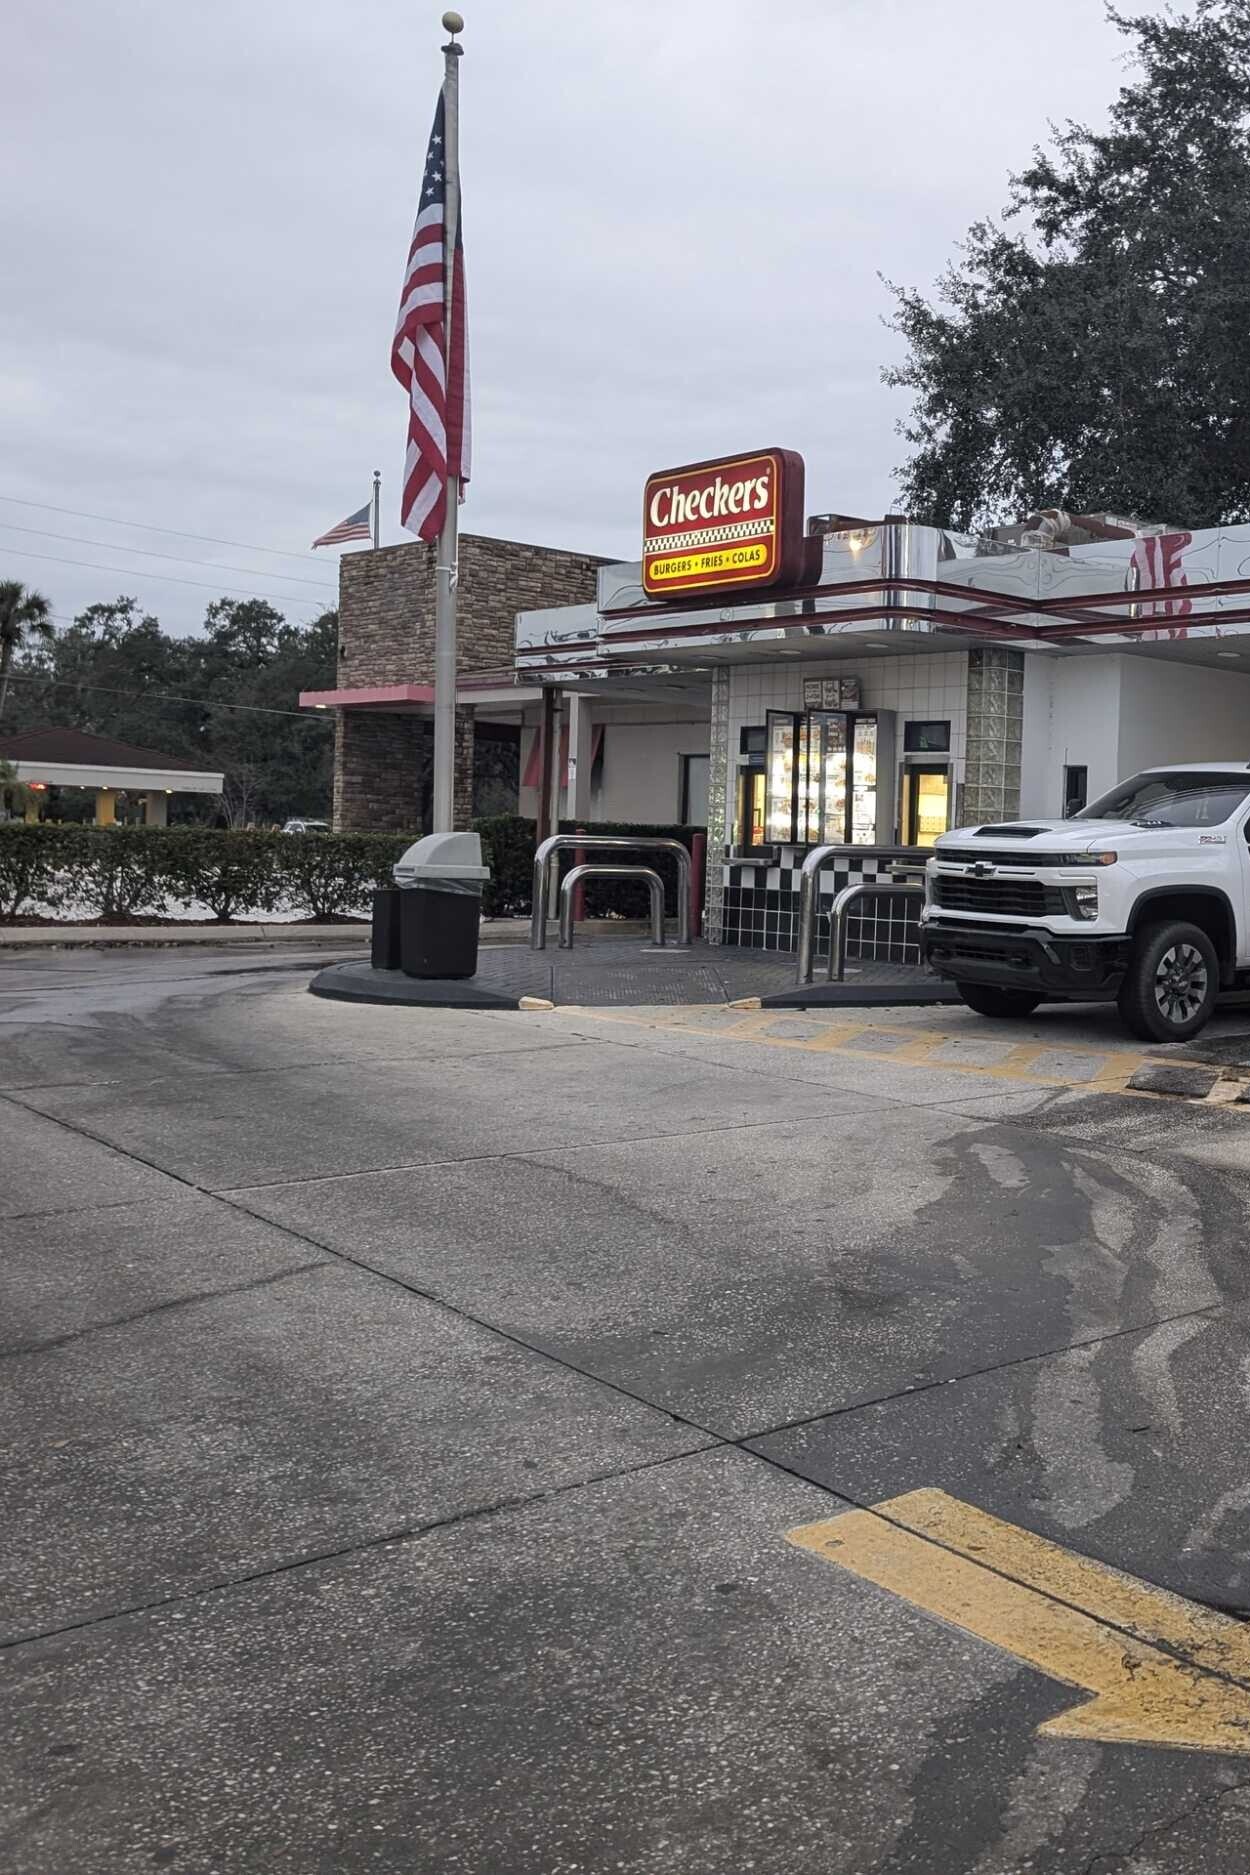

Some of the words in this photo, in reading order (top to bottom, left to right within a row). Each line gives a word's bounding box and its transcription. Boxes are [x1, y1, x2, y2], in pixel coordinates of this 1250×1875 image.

[650, 476, 769, 527] Checkers
[654, 560, 692, 575] BURGERS
[701, 555, 724, 569] FRIES
[732, 549, 761, 565] COLAS
